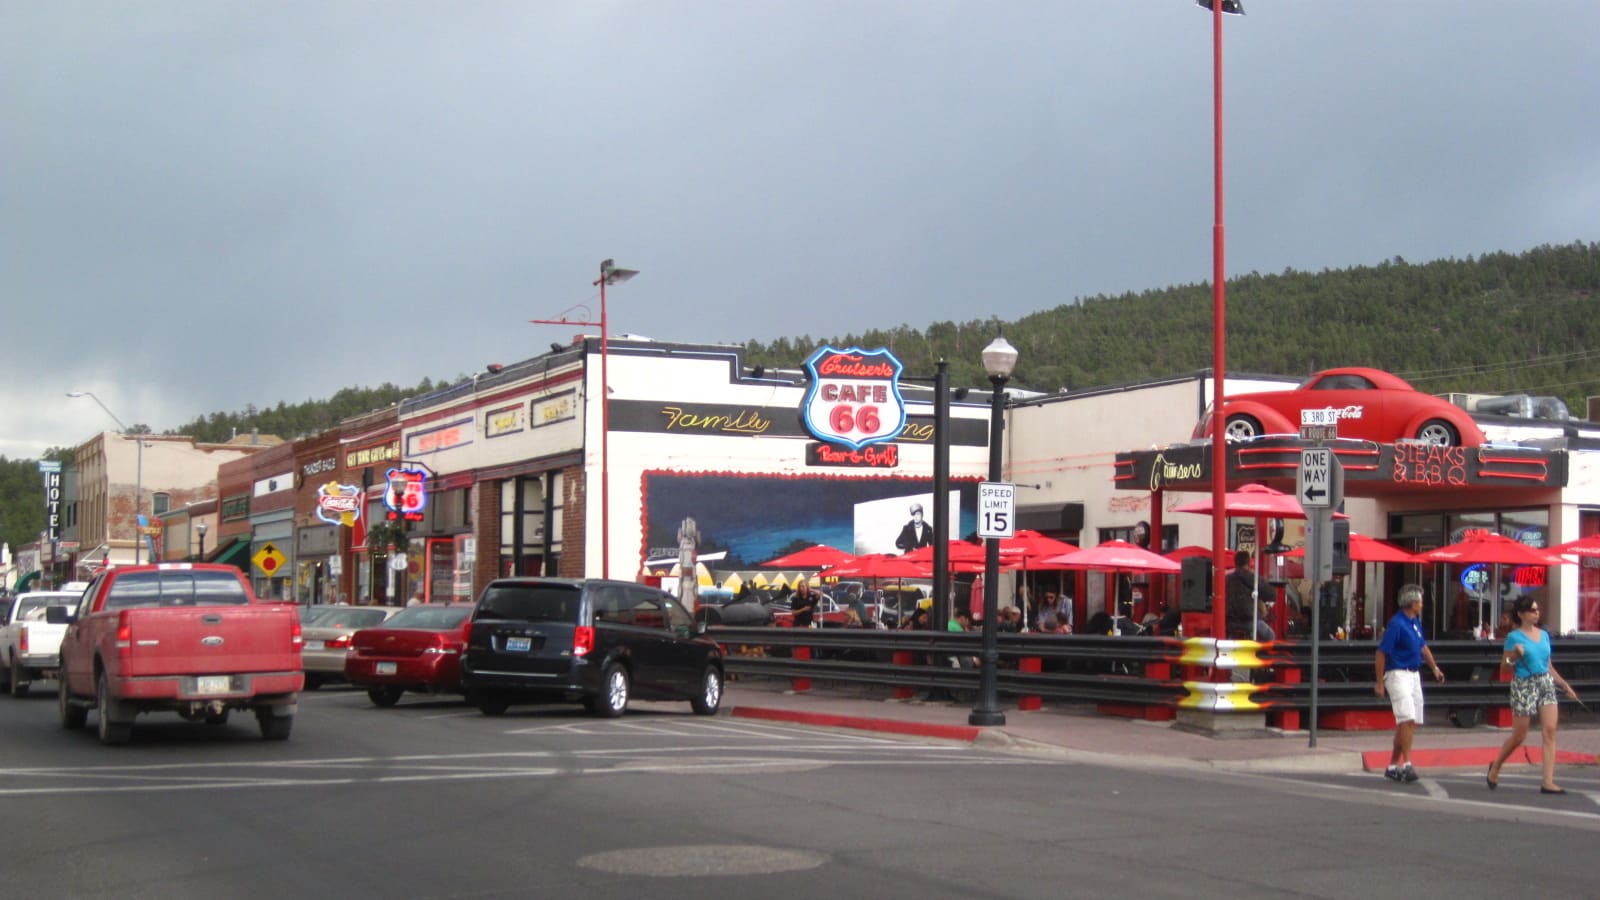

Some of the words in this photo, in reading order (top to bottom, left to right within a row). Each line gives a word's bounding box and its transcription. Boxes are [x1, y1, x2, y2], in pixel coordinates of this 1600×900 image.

[820, 353, 894, 377] Cruiser's
[820, 383, 888, 403] CAFE
[661, 406, 771, 433] Family
[829, 404, 881, 435] 66
[1302, 411, 1308, 423] S
[1311, 411, 1325, 423] 3RD
[1328, 411, 1336, 423] ST
[816, 445, 849, 462] Bar
[1305, 452, 1326, 466] ONE
[1395, 442, 1467, 466] STEAKS
[1304, 469, 1327, 482] WAY
[1393, 463, 1407, 482] &
[982, 488, 1012, 498] SPEED
[50, 473, 60, 541] HOTEL
[985, 500, 1008, 509] LIMIT
[985, 512, 1008, 532] 15
